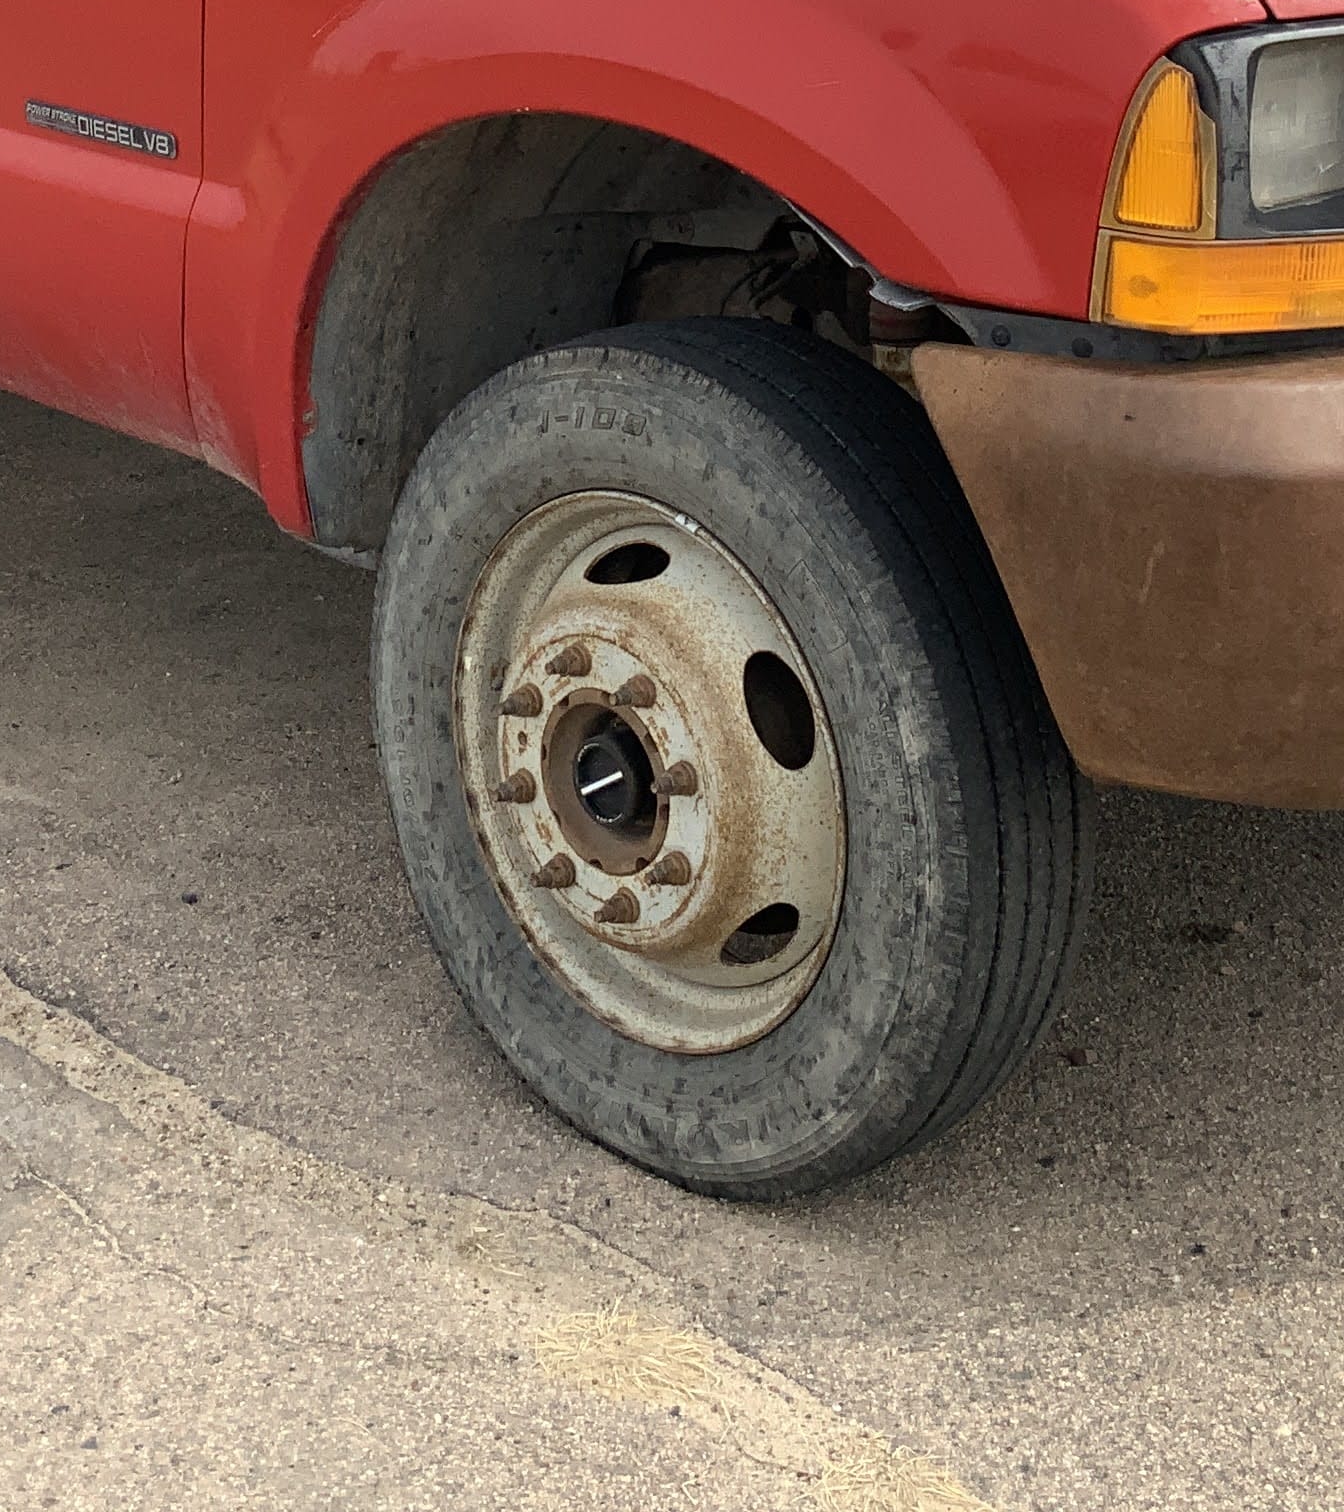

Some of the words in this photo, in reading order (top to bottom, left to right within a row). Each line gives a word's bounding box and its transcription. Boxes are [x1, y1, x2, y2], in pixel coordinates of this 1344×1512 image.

[26, 102, 51, 119] POWER
[51, 109, 77, 125] STROKE
[77, 115, 143, 149] DIESEL
[143, 131, 169, 155] V8
